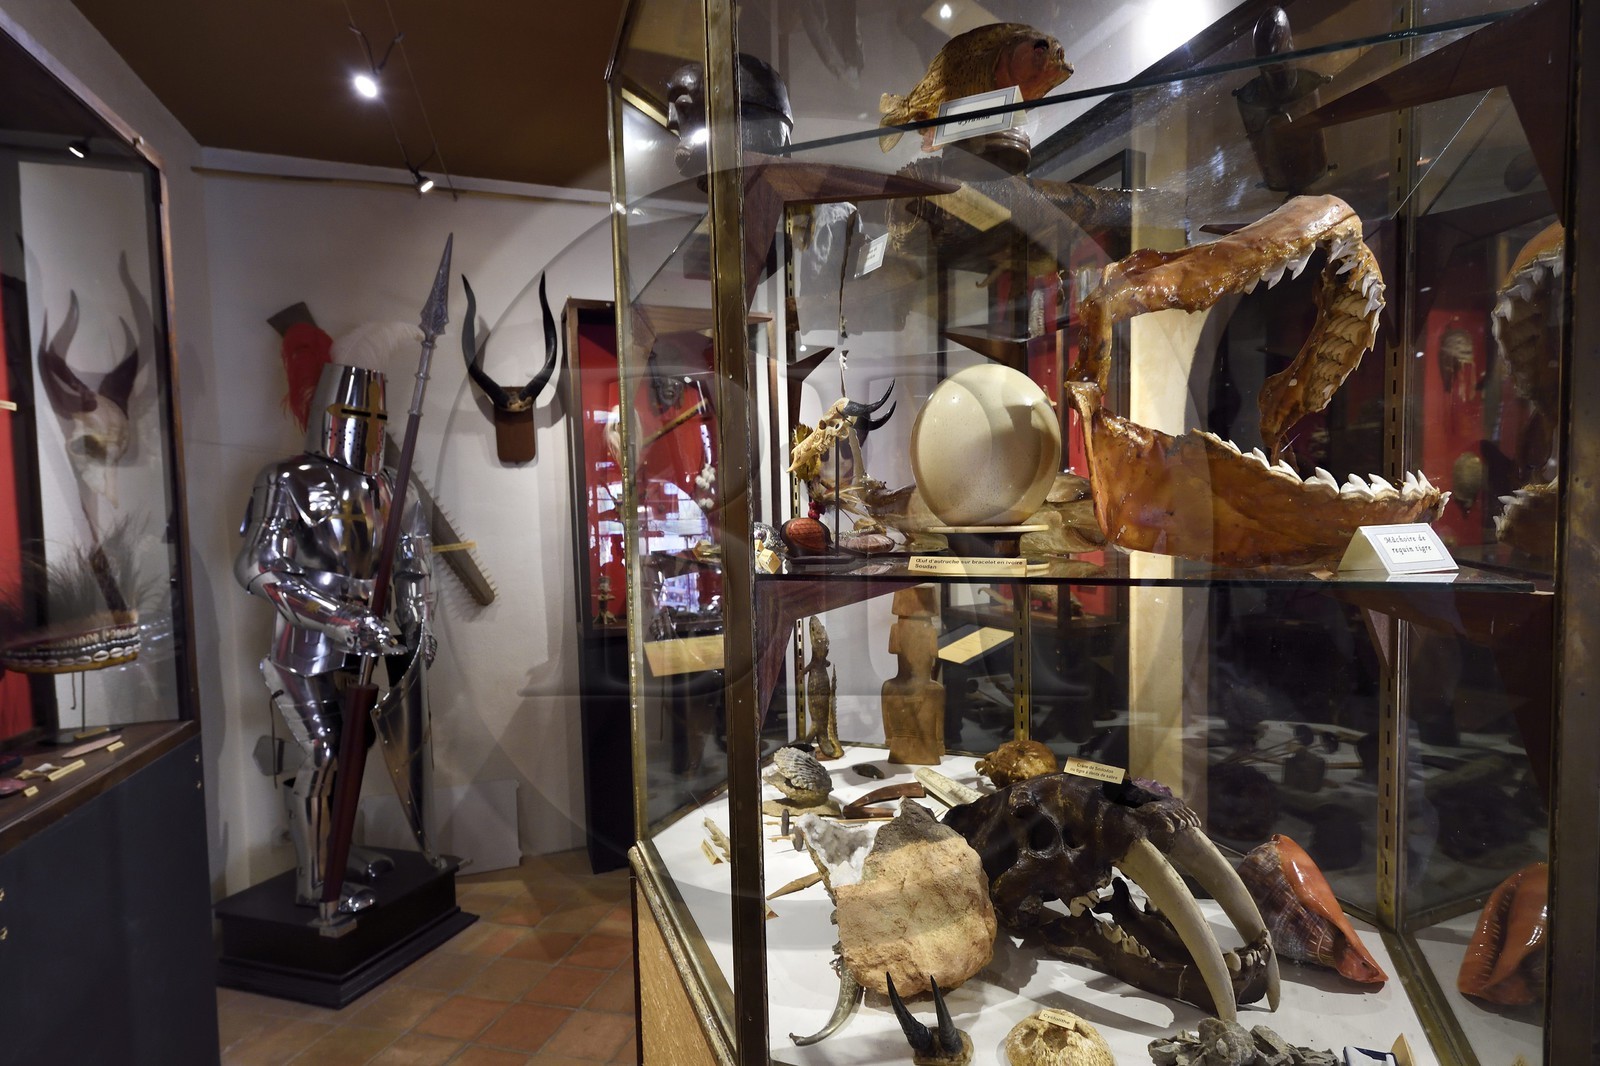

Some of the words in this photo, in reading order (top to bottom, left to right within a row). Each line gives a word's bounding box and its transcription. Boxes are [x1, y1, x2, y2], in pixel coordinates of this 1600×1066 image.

[1384, 535, 1416, 544] Mâchoire
[1392, 547, 1414, 555] requin
[1415, 545, 1432, 554] tigre
